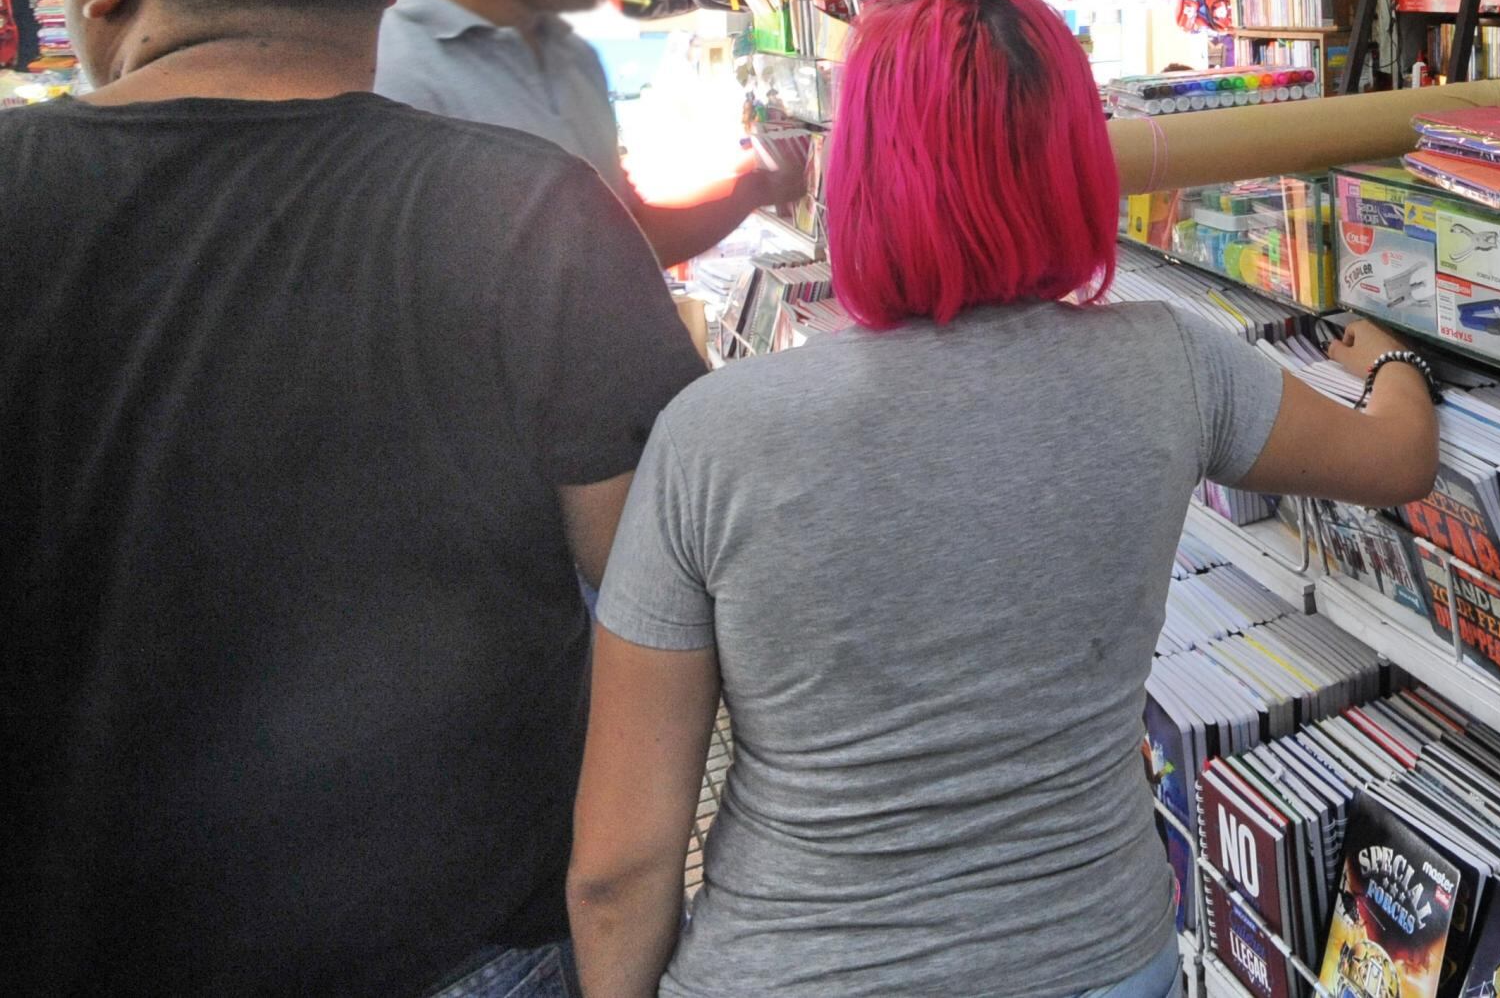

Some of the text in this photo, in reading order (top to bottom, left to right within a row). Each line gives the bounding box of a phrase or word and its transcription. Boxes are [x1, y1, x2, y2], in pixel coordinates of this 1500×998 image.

[1344, 262, 1373, 284] STAPLER
[1440, 327, 1473, 343] STAPLER
[1449, 503, 1489, 534] YOU
[1453, 574, 1490, 610] AND
[1217, 802, 1260, 898] NO
[1358, 845, 1433, 930] SPECIAL
[1422, 860, 1455, 892] master
[1366, 878, 1416, 935] FORCES
